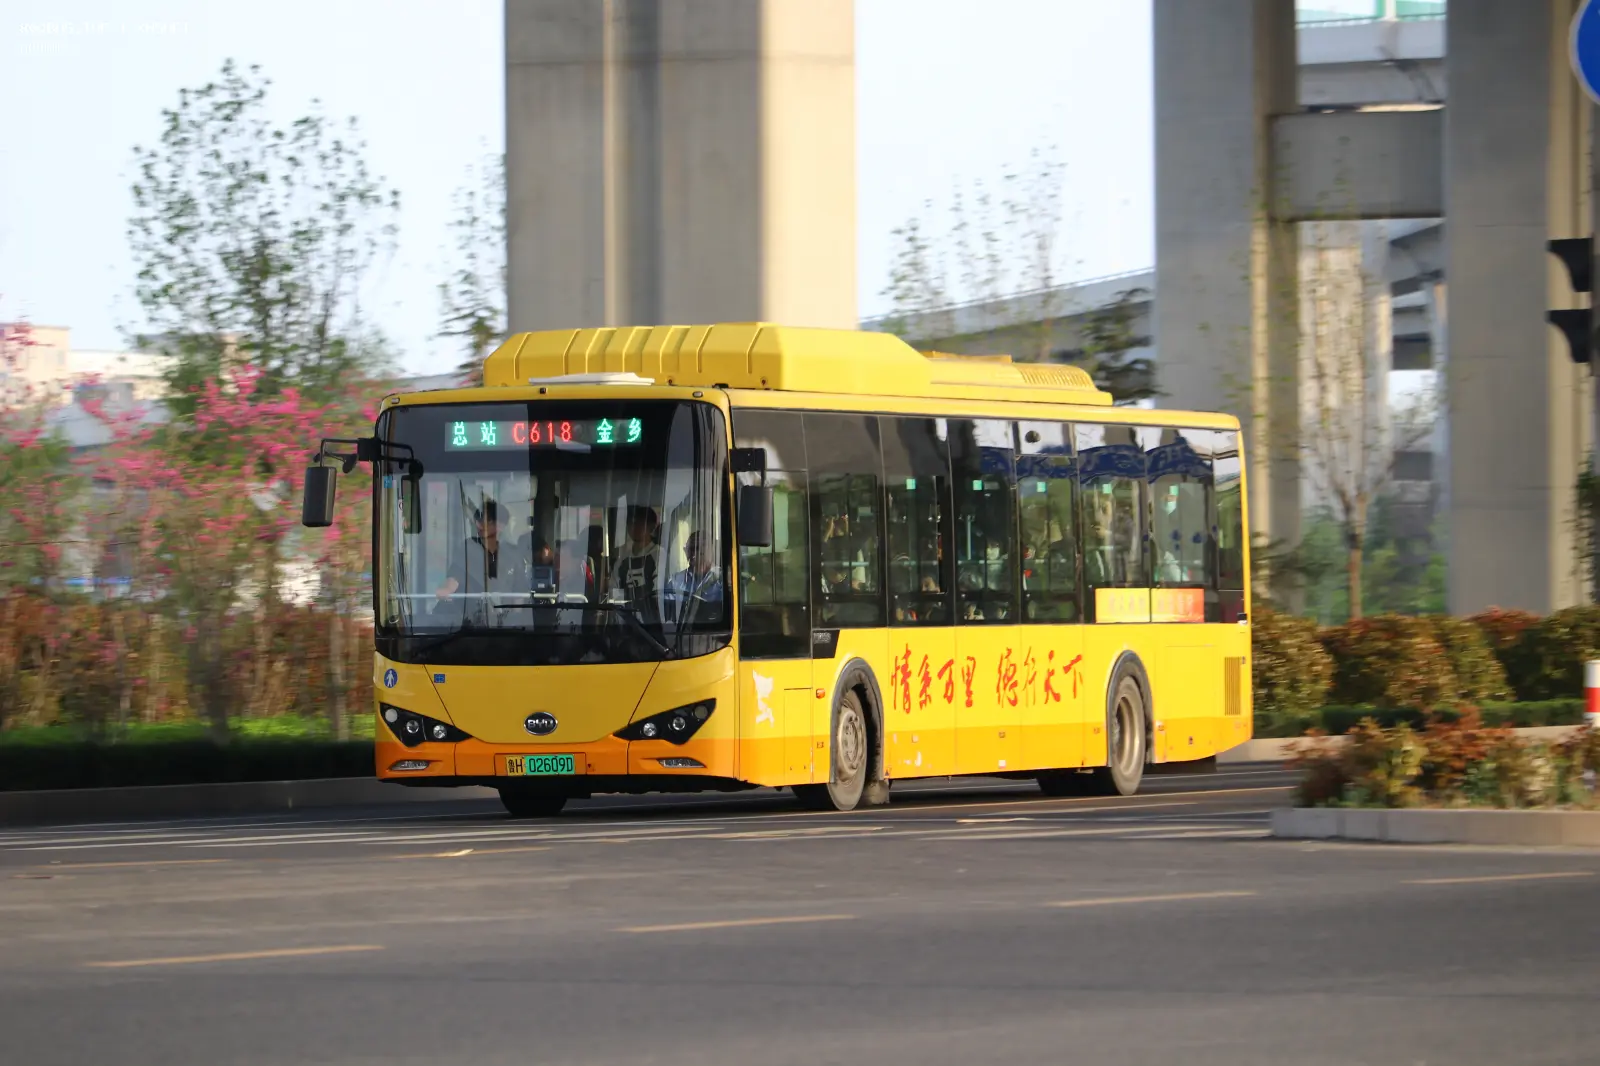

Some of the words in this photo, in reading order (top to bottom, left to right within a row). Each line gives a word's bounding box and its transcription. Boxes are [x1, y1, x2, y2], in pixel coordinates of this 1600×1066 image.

[452, 420, 497, 446] 总站
[512, 421, 572, 444] C618
[596, 417, 642, 444] 金乡
[890, 643, 977, 715] 情系万里
[996, 646, 1084, 709] 德行天下
[527, 719, 554, 728] BYD
